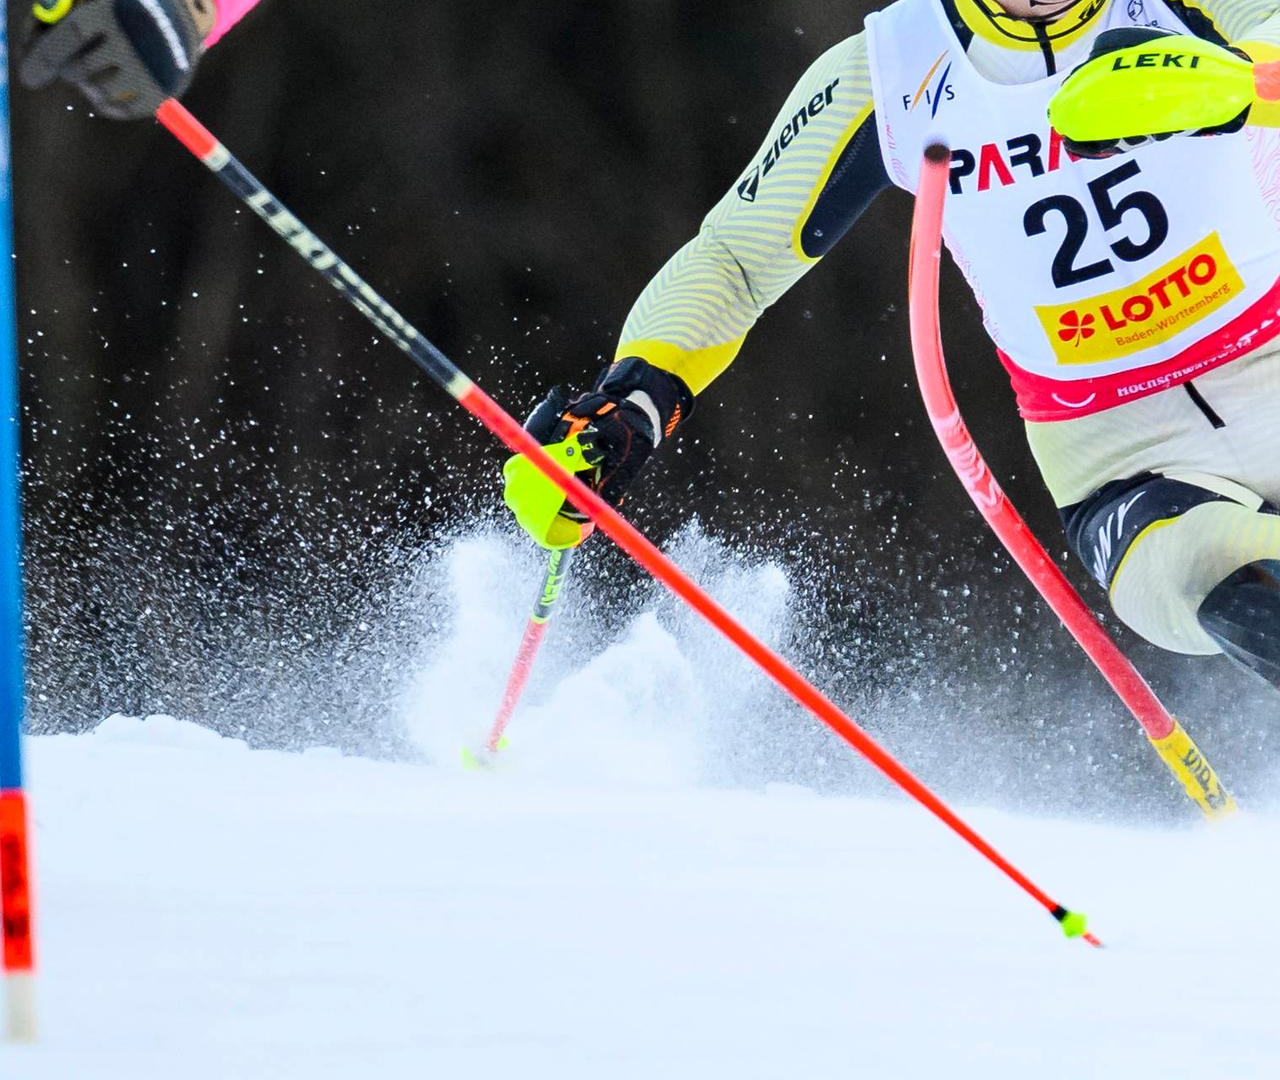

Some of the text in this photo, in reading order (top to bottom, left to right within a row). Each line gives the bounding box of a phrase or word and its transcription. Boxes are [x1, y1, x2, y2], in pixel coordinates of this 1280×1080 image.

[1111, 52, 1200, 71] LEKI
[761, 77, 840, 178] ziener
[1023, 159, 1169, 289] 25
[1100, 254, 1217, 332] LOTTO
[1115, 281, 1231, 347] Baden-Württemberg
